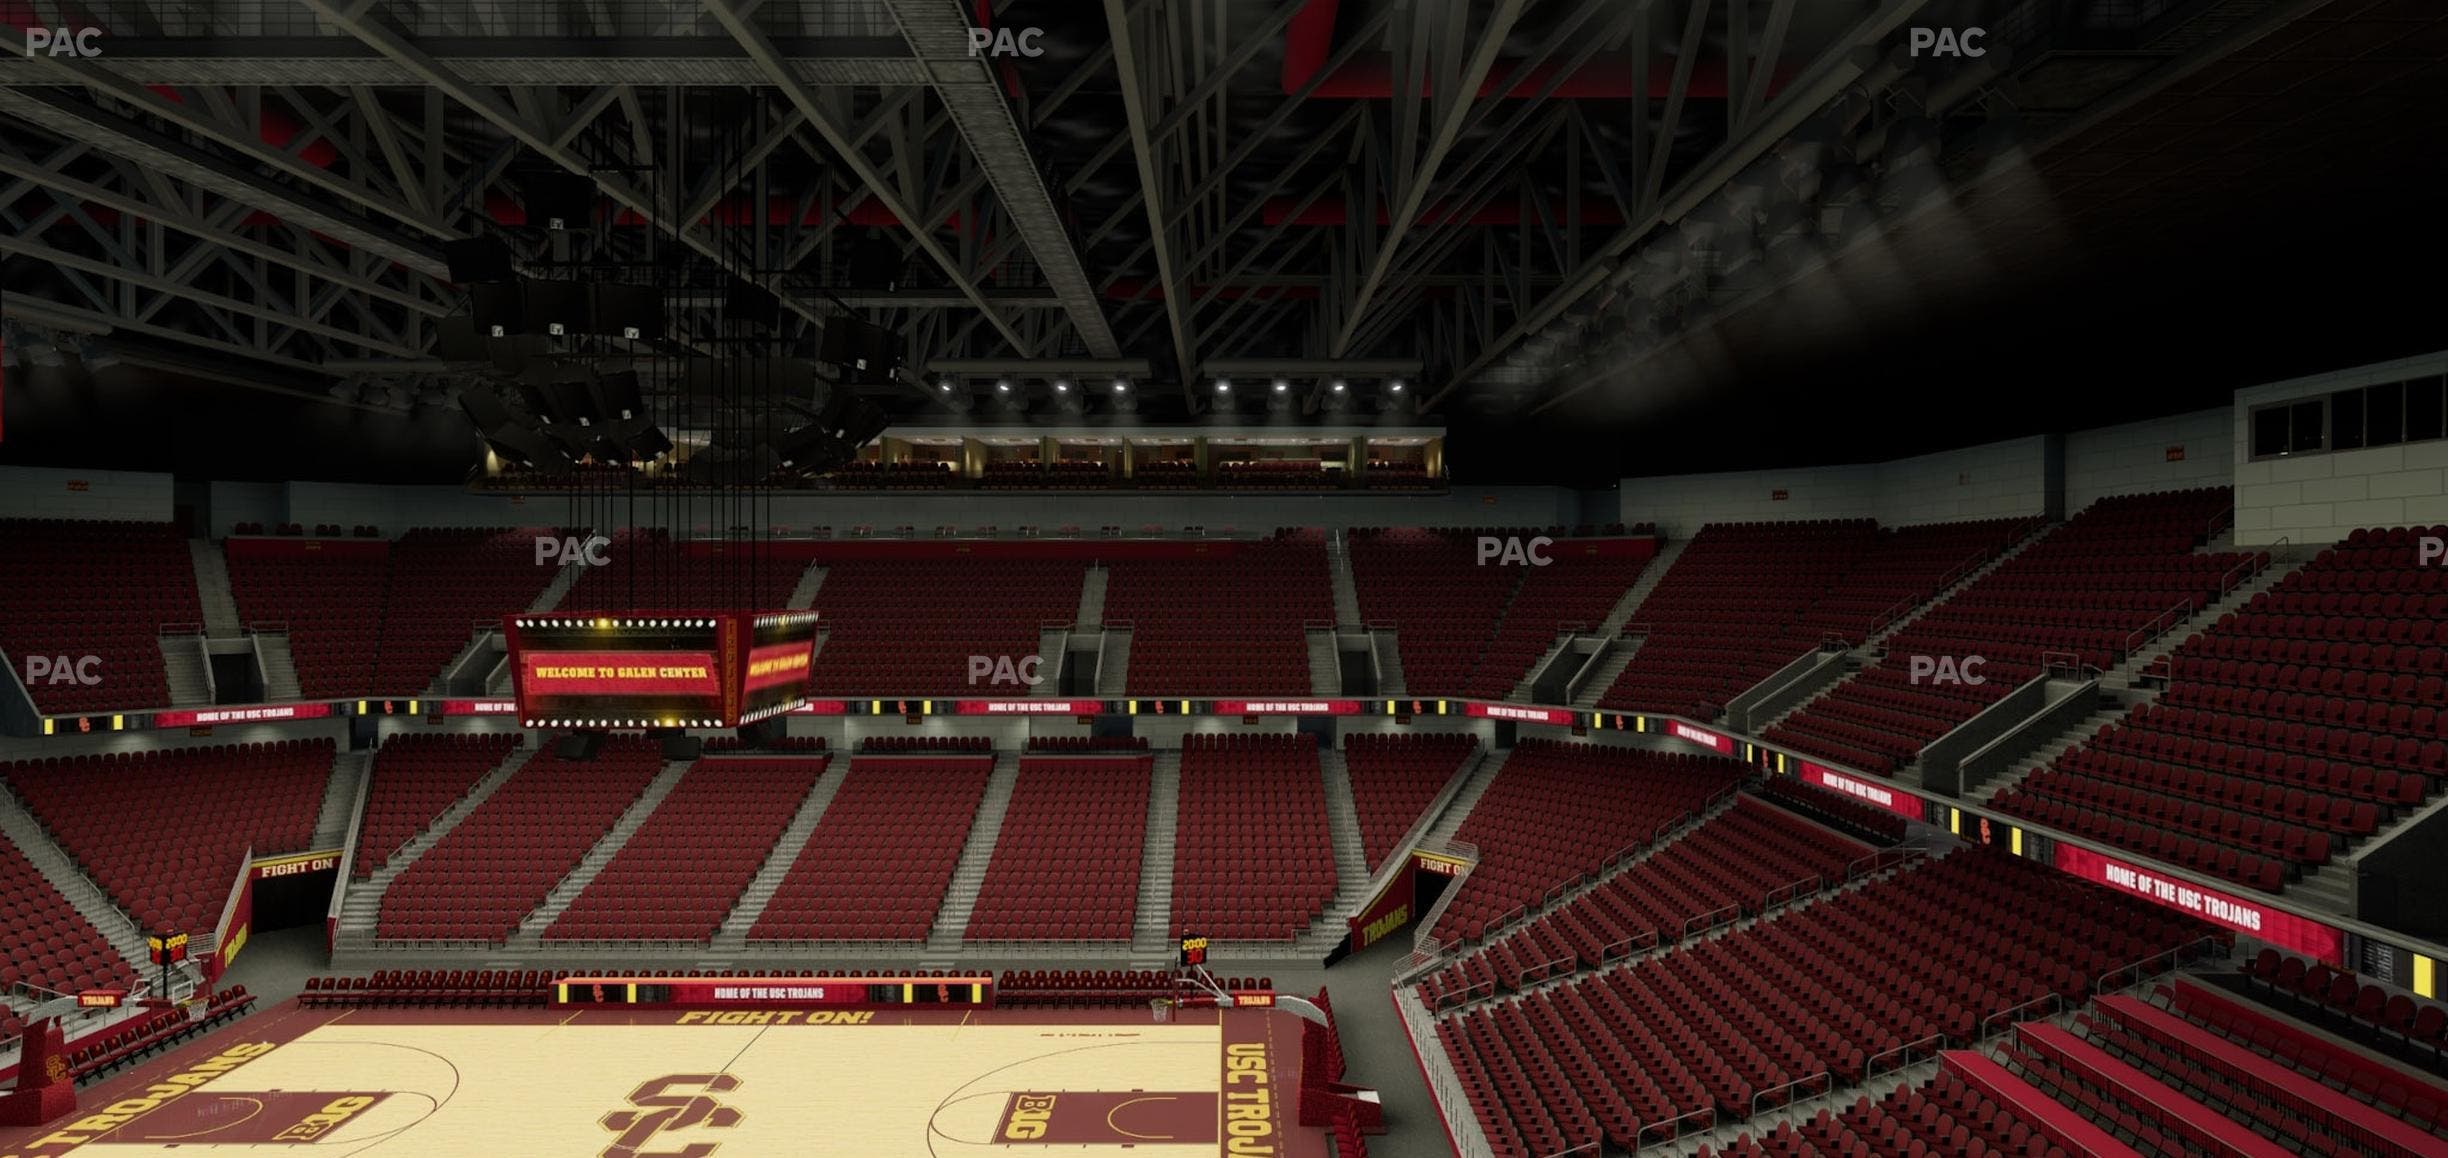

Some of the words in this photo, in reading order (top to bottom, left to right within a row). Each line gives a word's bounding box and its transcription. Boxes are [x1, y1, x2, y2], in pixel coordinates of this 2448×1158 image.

[536, 667, 595, 678] WELCOME
[598, 667, 614, 678] TO
[618, 667, 656, 678] GALEN
[660, 667, 707, 679] CENTER
[261, 861, 308, 878] FIGHT
[312, 858, 333, 871] ON
[1420, 858, 1452, 874] FIGHT
[2106, 863, 2136, 889] HOME
[2138, 873, 2152, 894] OF
[2153, 878, 2175, 903] THE
[2178, 887, 2201, 911] USC
[2204, 895, 2261, 931] TROJANS
[1182, 937, 1207, 950] 20:00
[714, 987, 739, 999] HOME
[740, 987, 750, 999] OF
[751, 987, 768, 999] THE
[769, 987, 786, 999] USC
[787, 987, 824, 999] TROJANS
[675, 1011, 804, 1025] FIGHT
[805, 1011, 875, 1025] ON!
[1227, 1043, 1268, 1084] USC
[25, 1043, 276, 1150] TROJANS
[1227, 1088, 1274, 1158] TROJ
